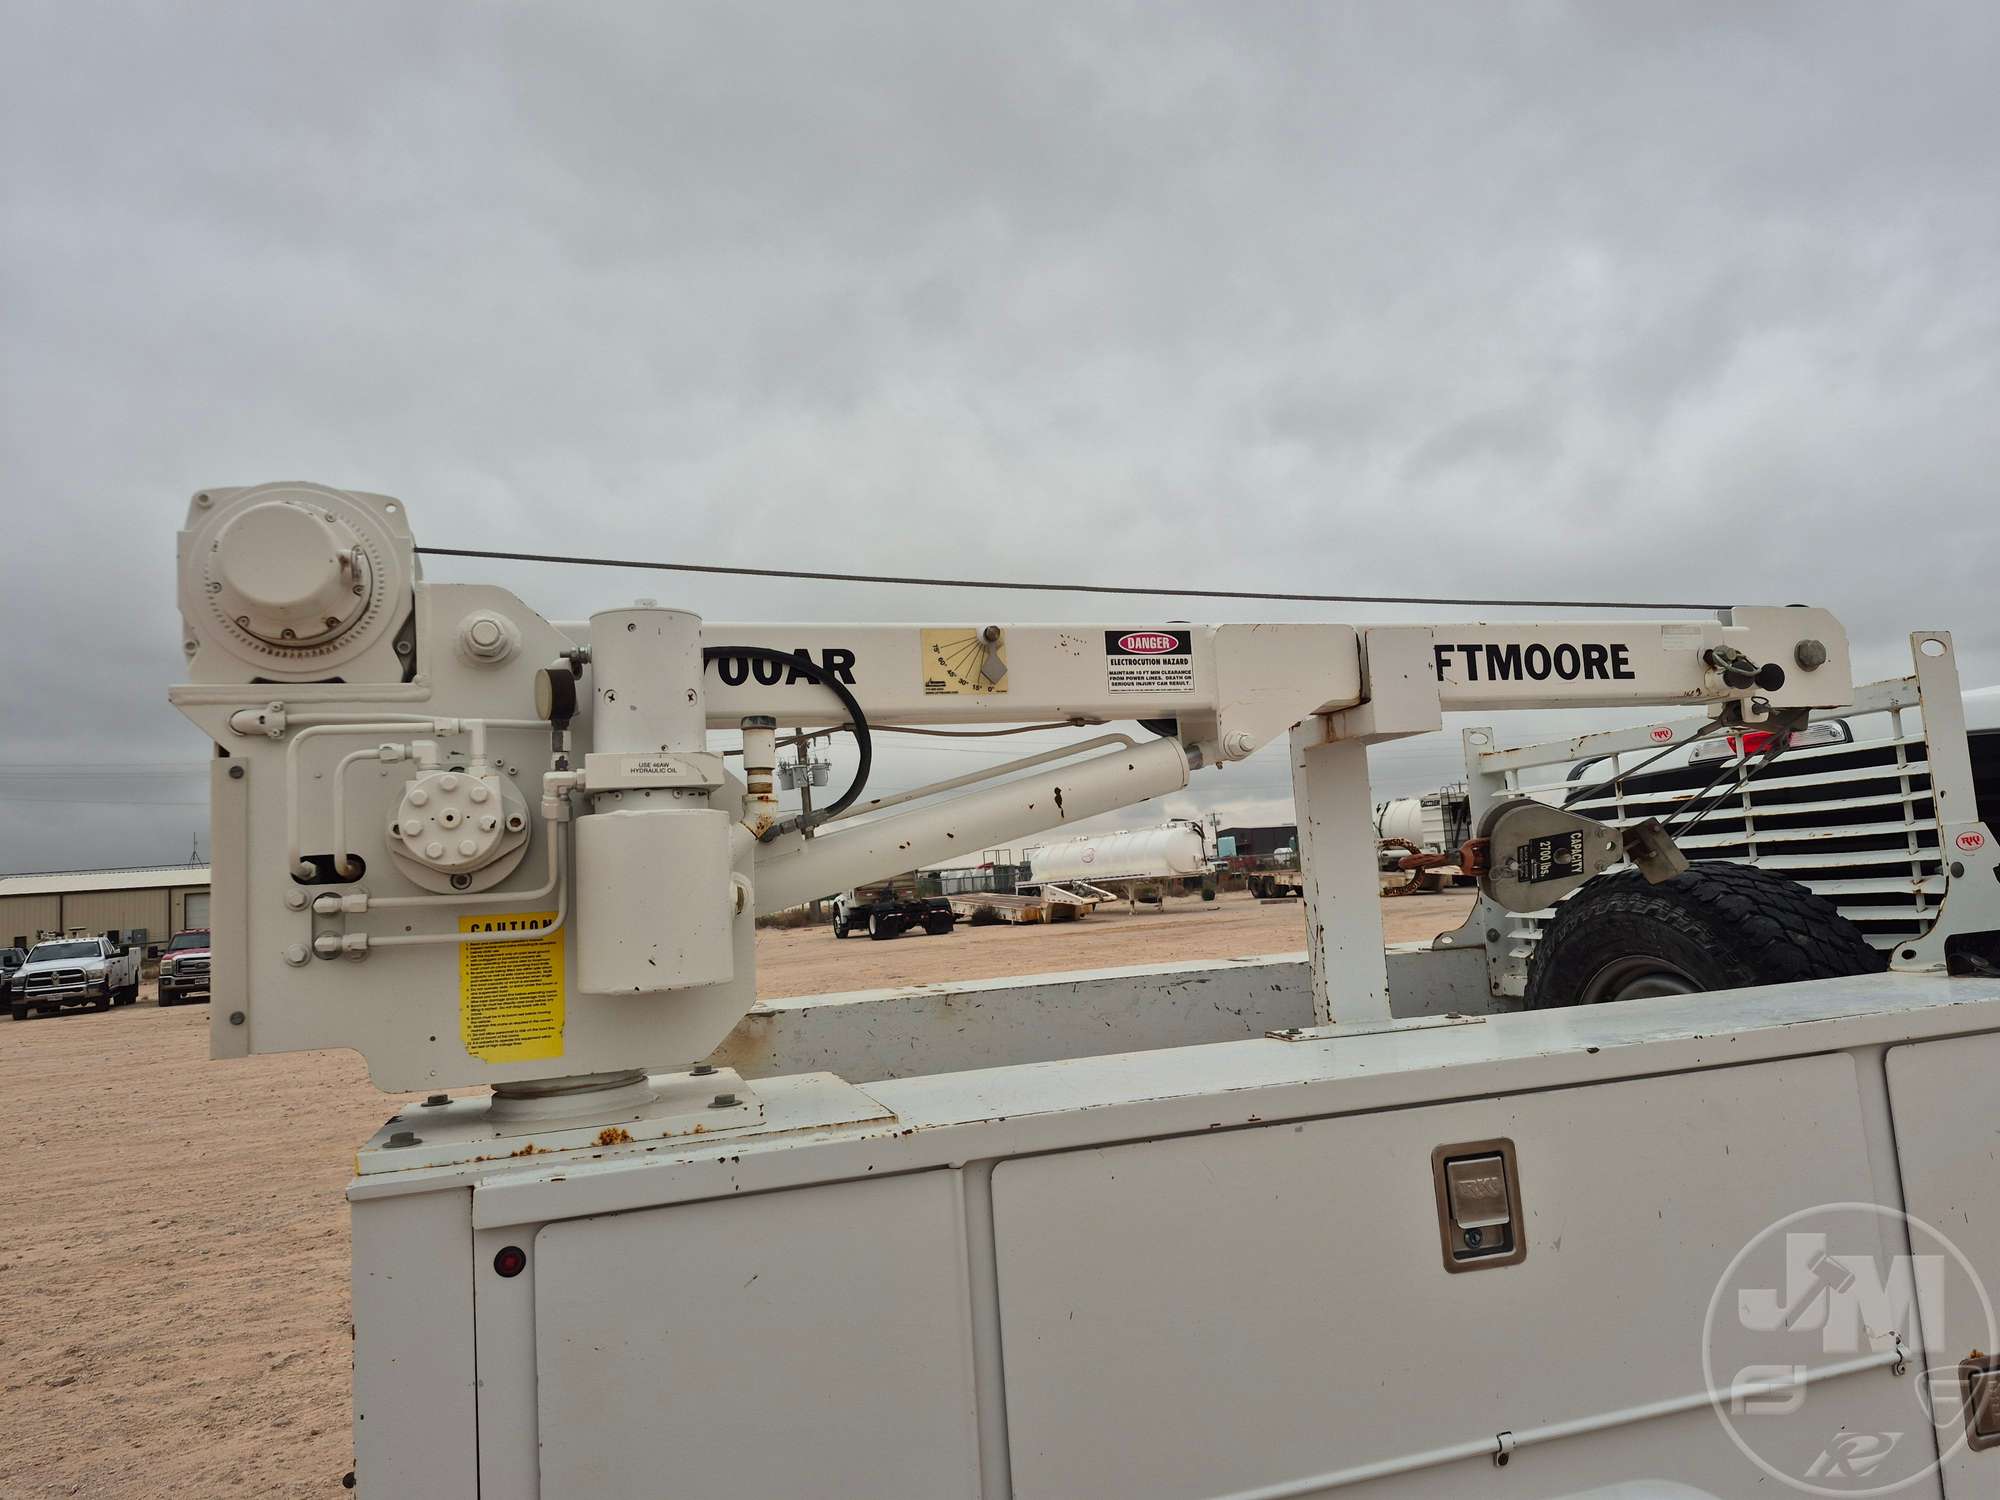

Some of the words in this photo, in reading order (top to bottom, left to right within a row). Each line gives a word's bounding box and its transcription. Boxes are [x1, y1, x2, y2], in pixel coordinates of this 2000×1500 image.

[1127, 637, 1170, 649] DANGER
[1110, 658, 1161, 666] ELECTROCUTION
[1162, 658, 1189, 666] HAZARD
[1433, 643, 1636, 682] FTMOORE
[1540, 840, 1552, 861] 2700
[1570, 832, 1583, 873] CAPACITY
[470, 918, 554, 933] CAUTION
